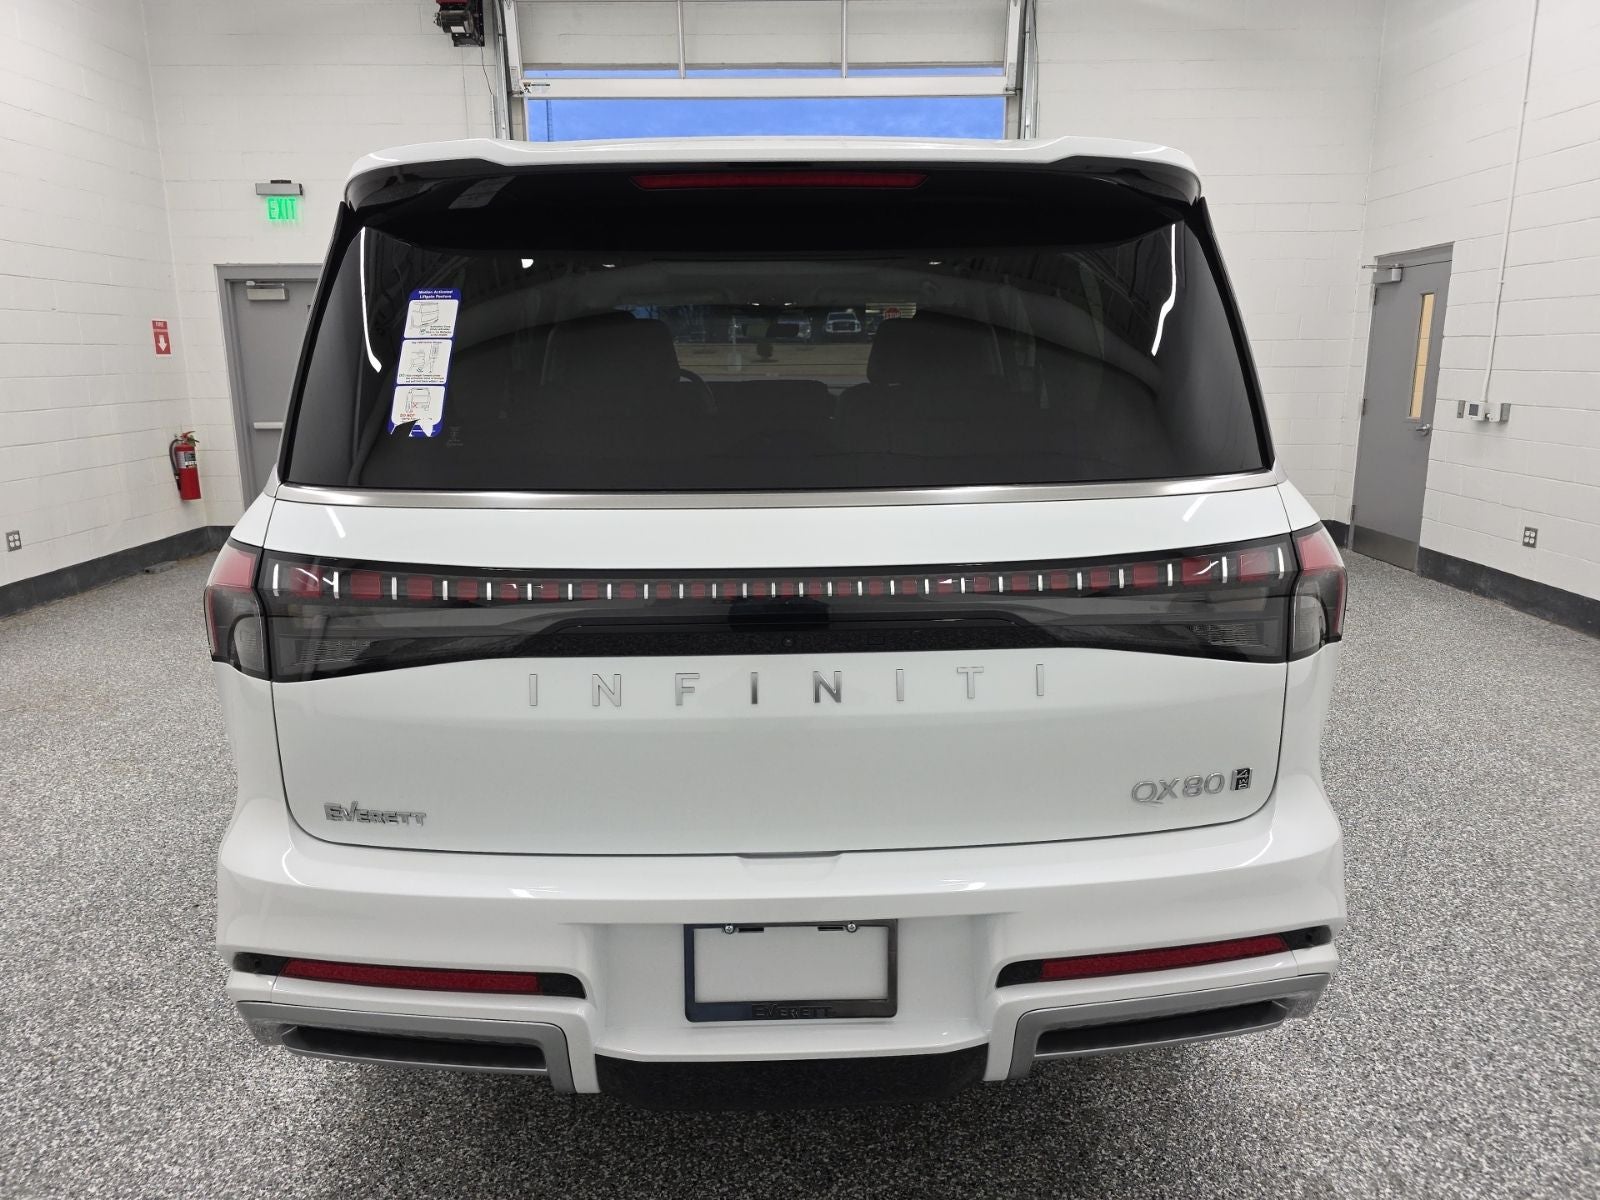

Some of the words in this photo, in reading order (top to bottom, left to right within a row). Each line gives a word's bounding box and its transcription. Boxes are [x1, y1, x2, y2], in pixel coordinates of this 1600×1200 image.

[268, 198, 296, 220] EXIT
[528, 663, 1045, 707] INFINITI
[1131, 771, 1226, 805] QX80
[323, 799, 427, 827] EVERETT
